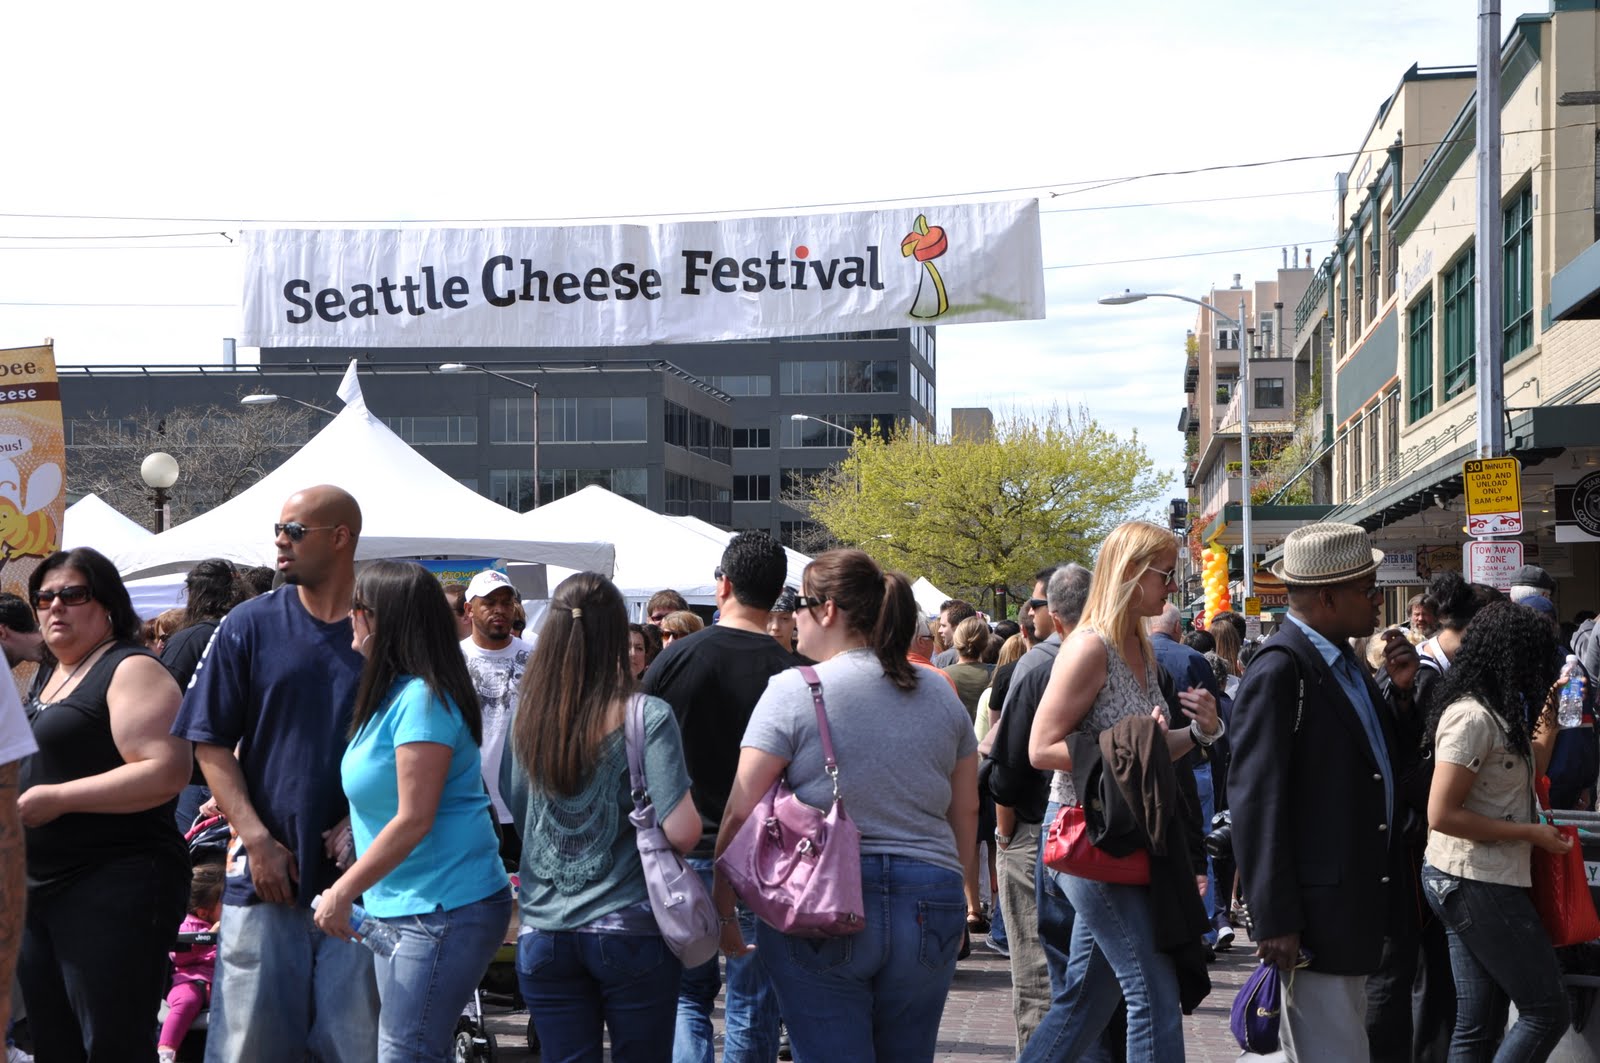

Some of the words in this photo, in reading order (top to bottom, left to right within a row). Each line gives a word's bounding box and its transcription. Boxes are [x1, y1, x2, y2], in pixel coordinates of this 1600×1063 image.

[283, 265, 470, 324] Seattle
[481, 254, 662, 307] Cheese
[680, 245, 885, 296] Festival
[1467, 461, 1481, 472] 30
[1484, 462, 1512, 470] MINUTE
[1471, 473, 1492, 481] LOAD
[1476, 480, 1508, 488] UNLOAD
[1482, 487, 1503, 495] ONLY
[1576, 509, 1599, 531] COFFEE
[1475, 546, 1492, 554] TOW
[1494, 545, 1516, 554] AWAY
[1400, 554, 1413, 563] BAR
[1484, 555, 1507, 563] ZONE
